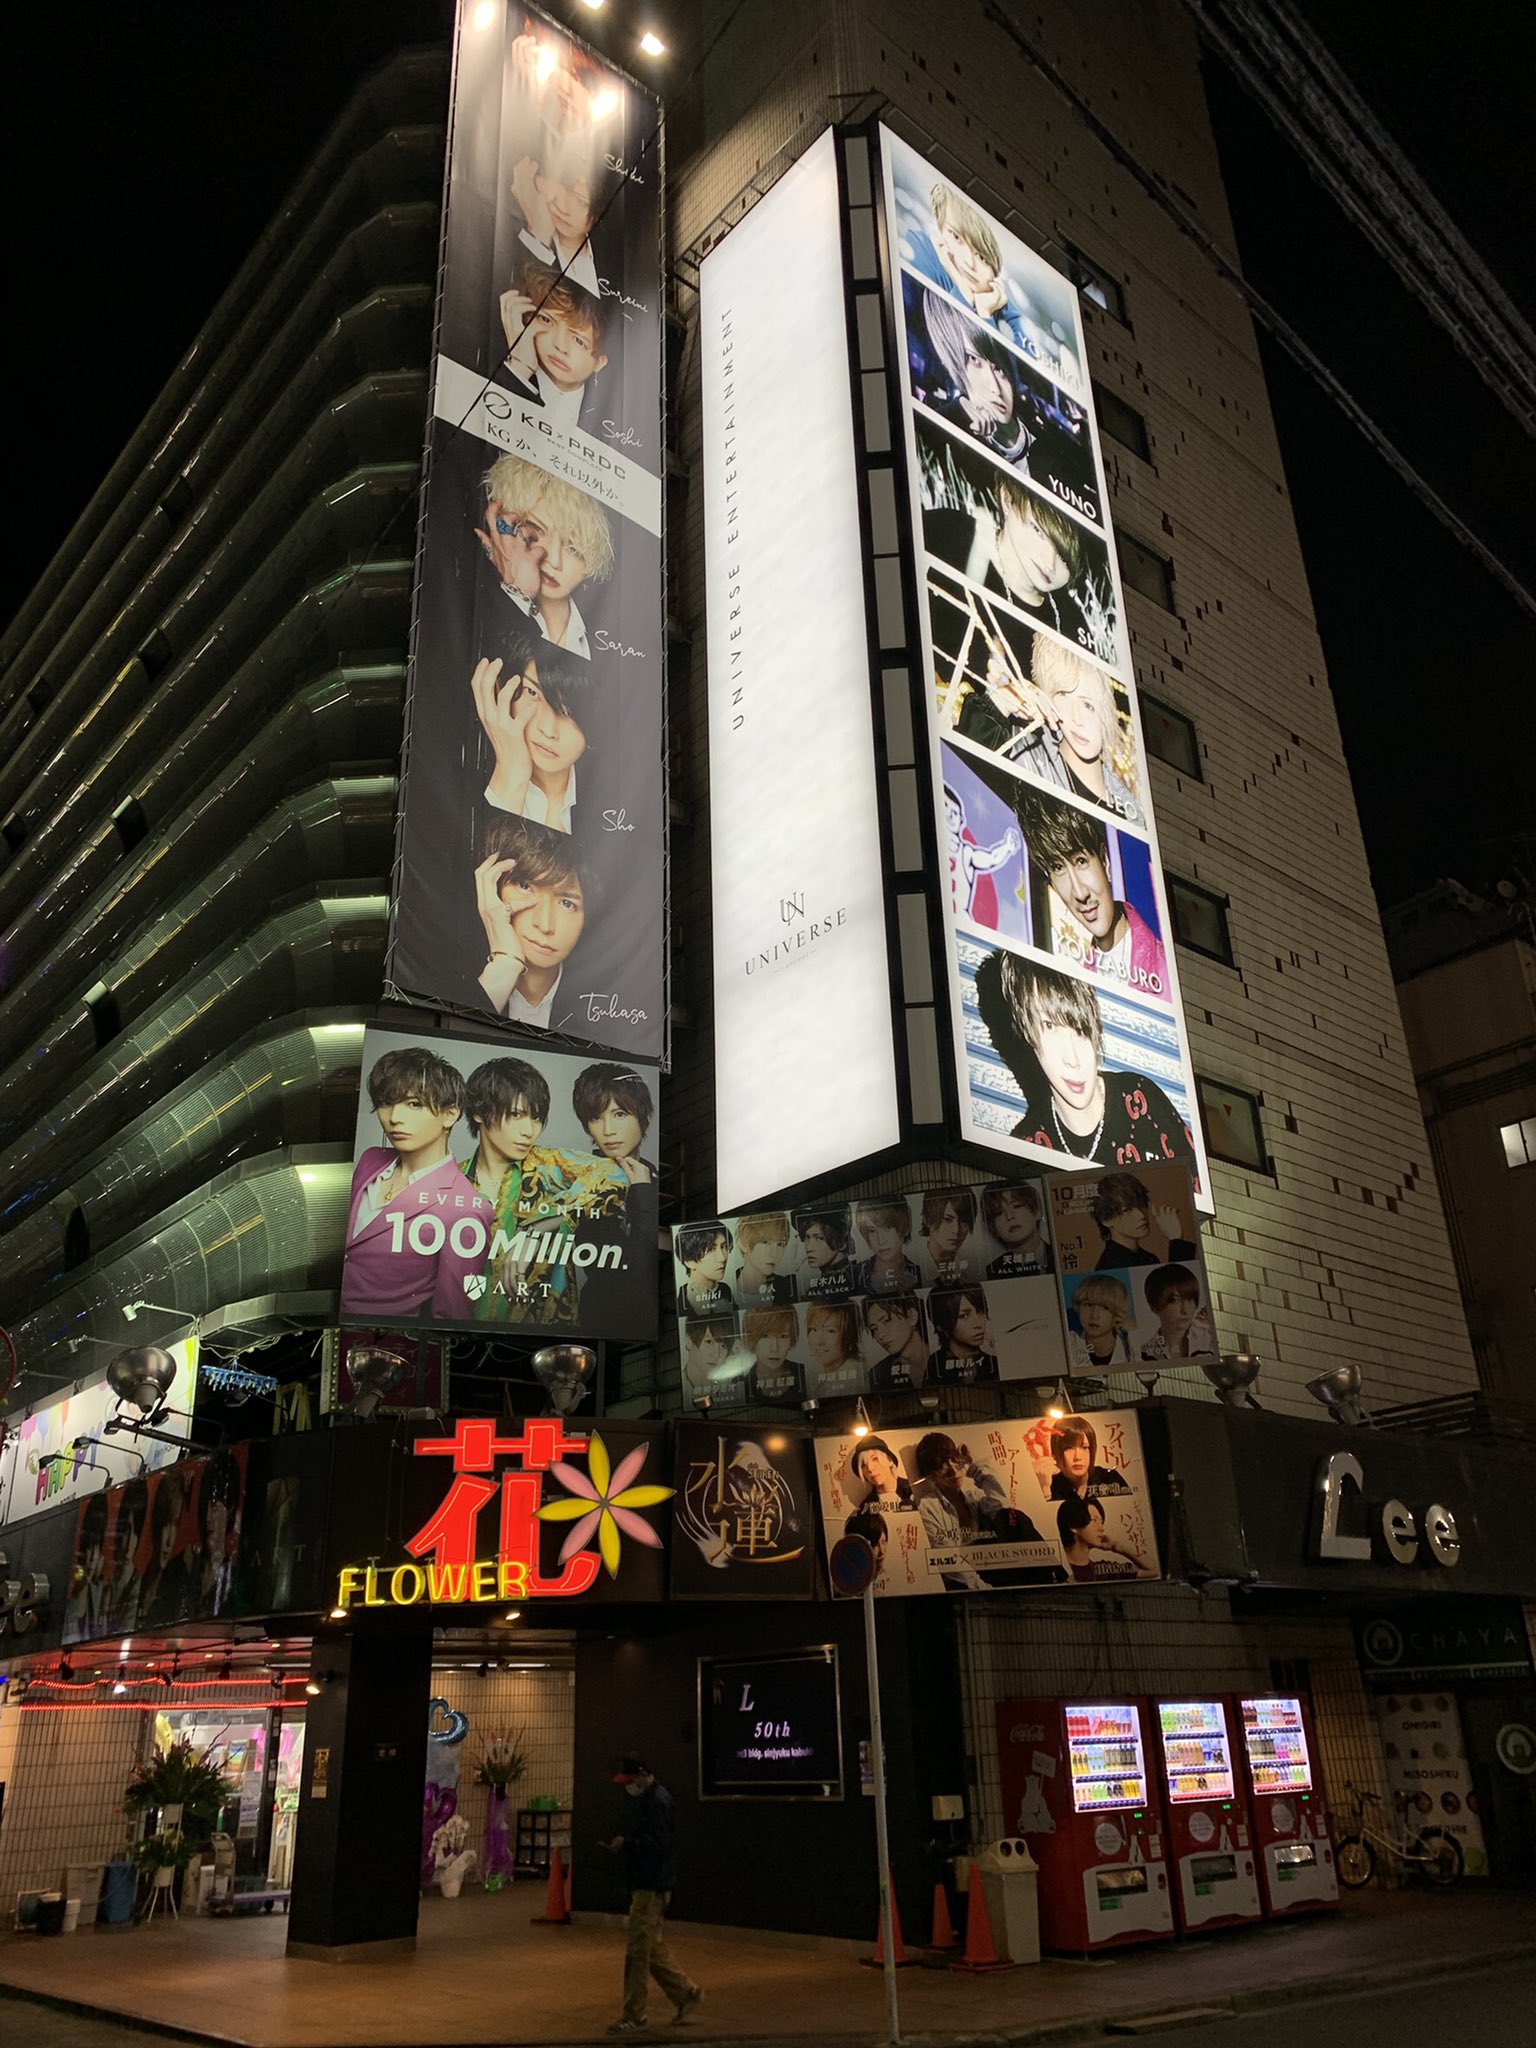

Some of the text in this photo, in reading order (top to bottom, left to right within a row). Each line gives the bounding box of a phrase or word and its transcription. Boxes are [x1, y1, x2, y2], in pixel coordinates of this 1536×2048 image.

[1048, 473, 1098, 521] YUNO
[721, 307, 746, 732] UNIVERSE ENTERTAINMENT
[1076, 625, 1119, 667] SHIN
[601, 808, 637, 833] Sho
[1104, 790, 1138, 822] LEO
[744, 906, 848, 977] UNIVERSE
[1055, 934, 1164, 994] KOUZABURO
[579, 991, 649, 1023] Tsukasa
[418, 1191, 601, 1221] EVERY MONTH
[695, 1289, 722, 1303] shiki
[1101, 1421, 1133, 1470] アイドル
[403, 1417, 602, 1600] 花
[1119, 1512, 1148, 1559] ハンサム
[972, 1548, 1010, 1562] BLACK
[337, 1560, 532, 1608] FLOWER
[738, 1683, 755, 1712] L
[753, 1720, 791, 1740] 50th
[1401, 1719, 1443, 1732] ONIGIRI
[1402, 1768, 1460, 1781] MISOSHIRU
